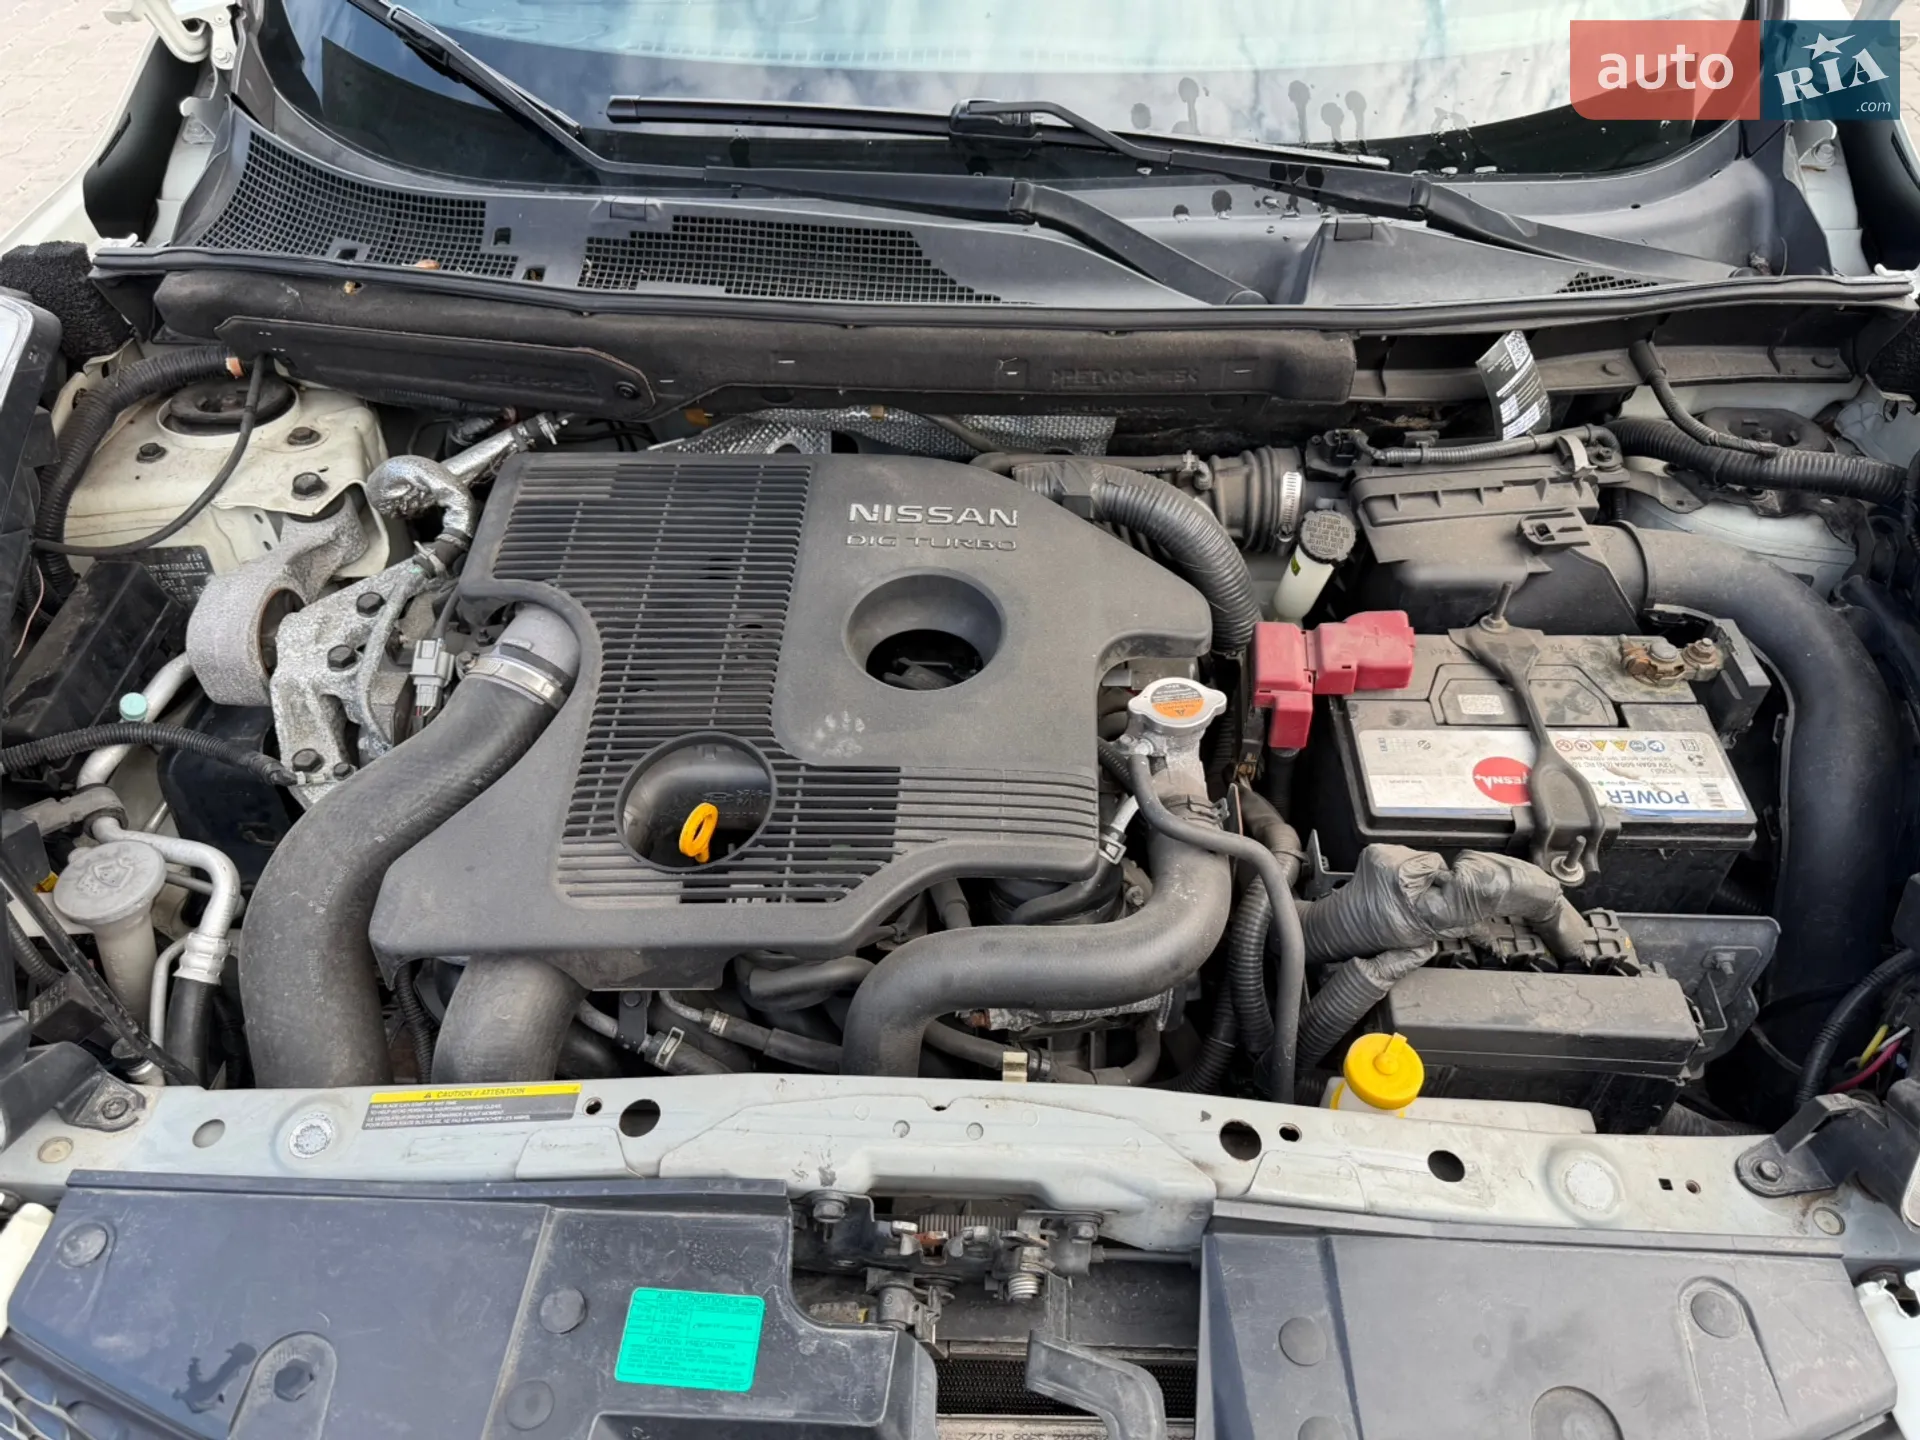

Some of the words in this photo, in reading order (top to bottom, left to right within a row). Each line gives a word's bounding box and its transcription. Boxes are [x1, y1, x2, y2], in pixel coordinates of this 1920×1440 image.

[849, 503, 1018, 527] NISSAN
[846, 535, 897, 548] DIG
[906, 536, 1017, 552] TURBO
[1605, 790, 1690, 804] POWER
[437, 1090, 472, 1098] CAUTION
[481, 1087, 526, 1096] ATTENTION
